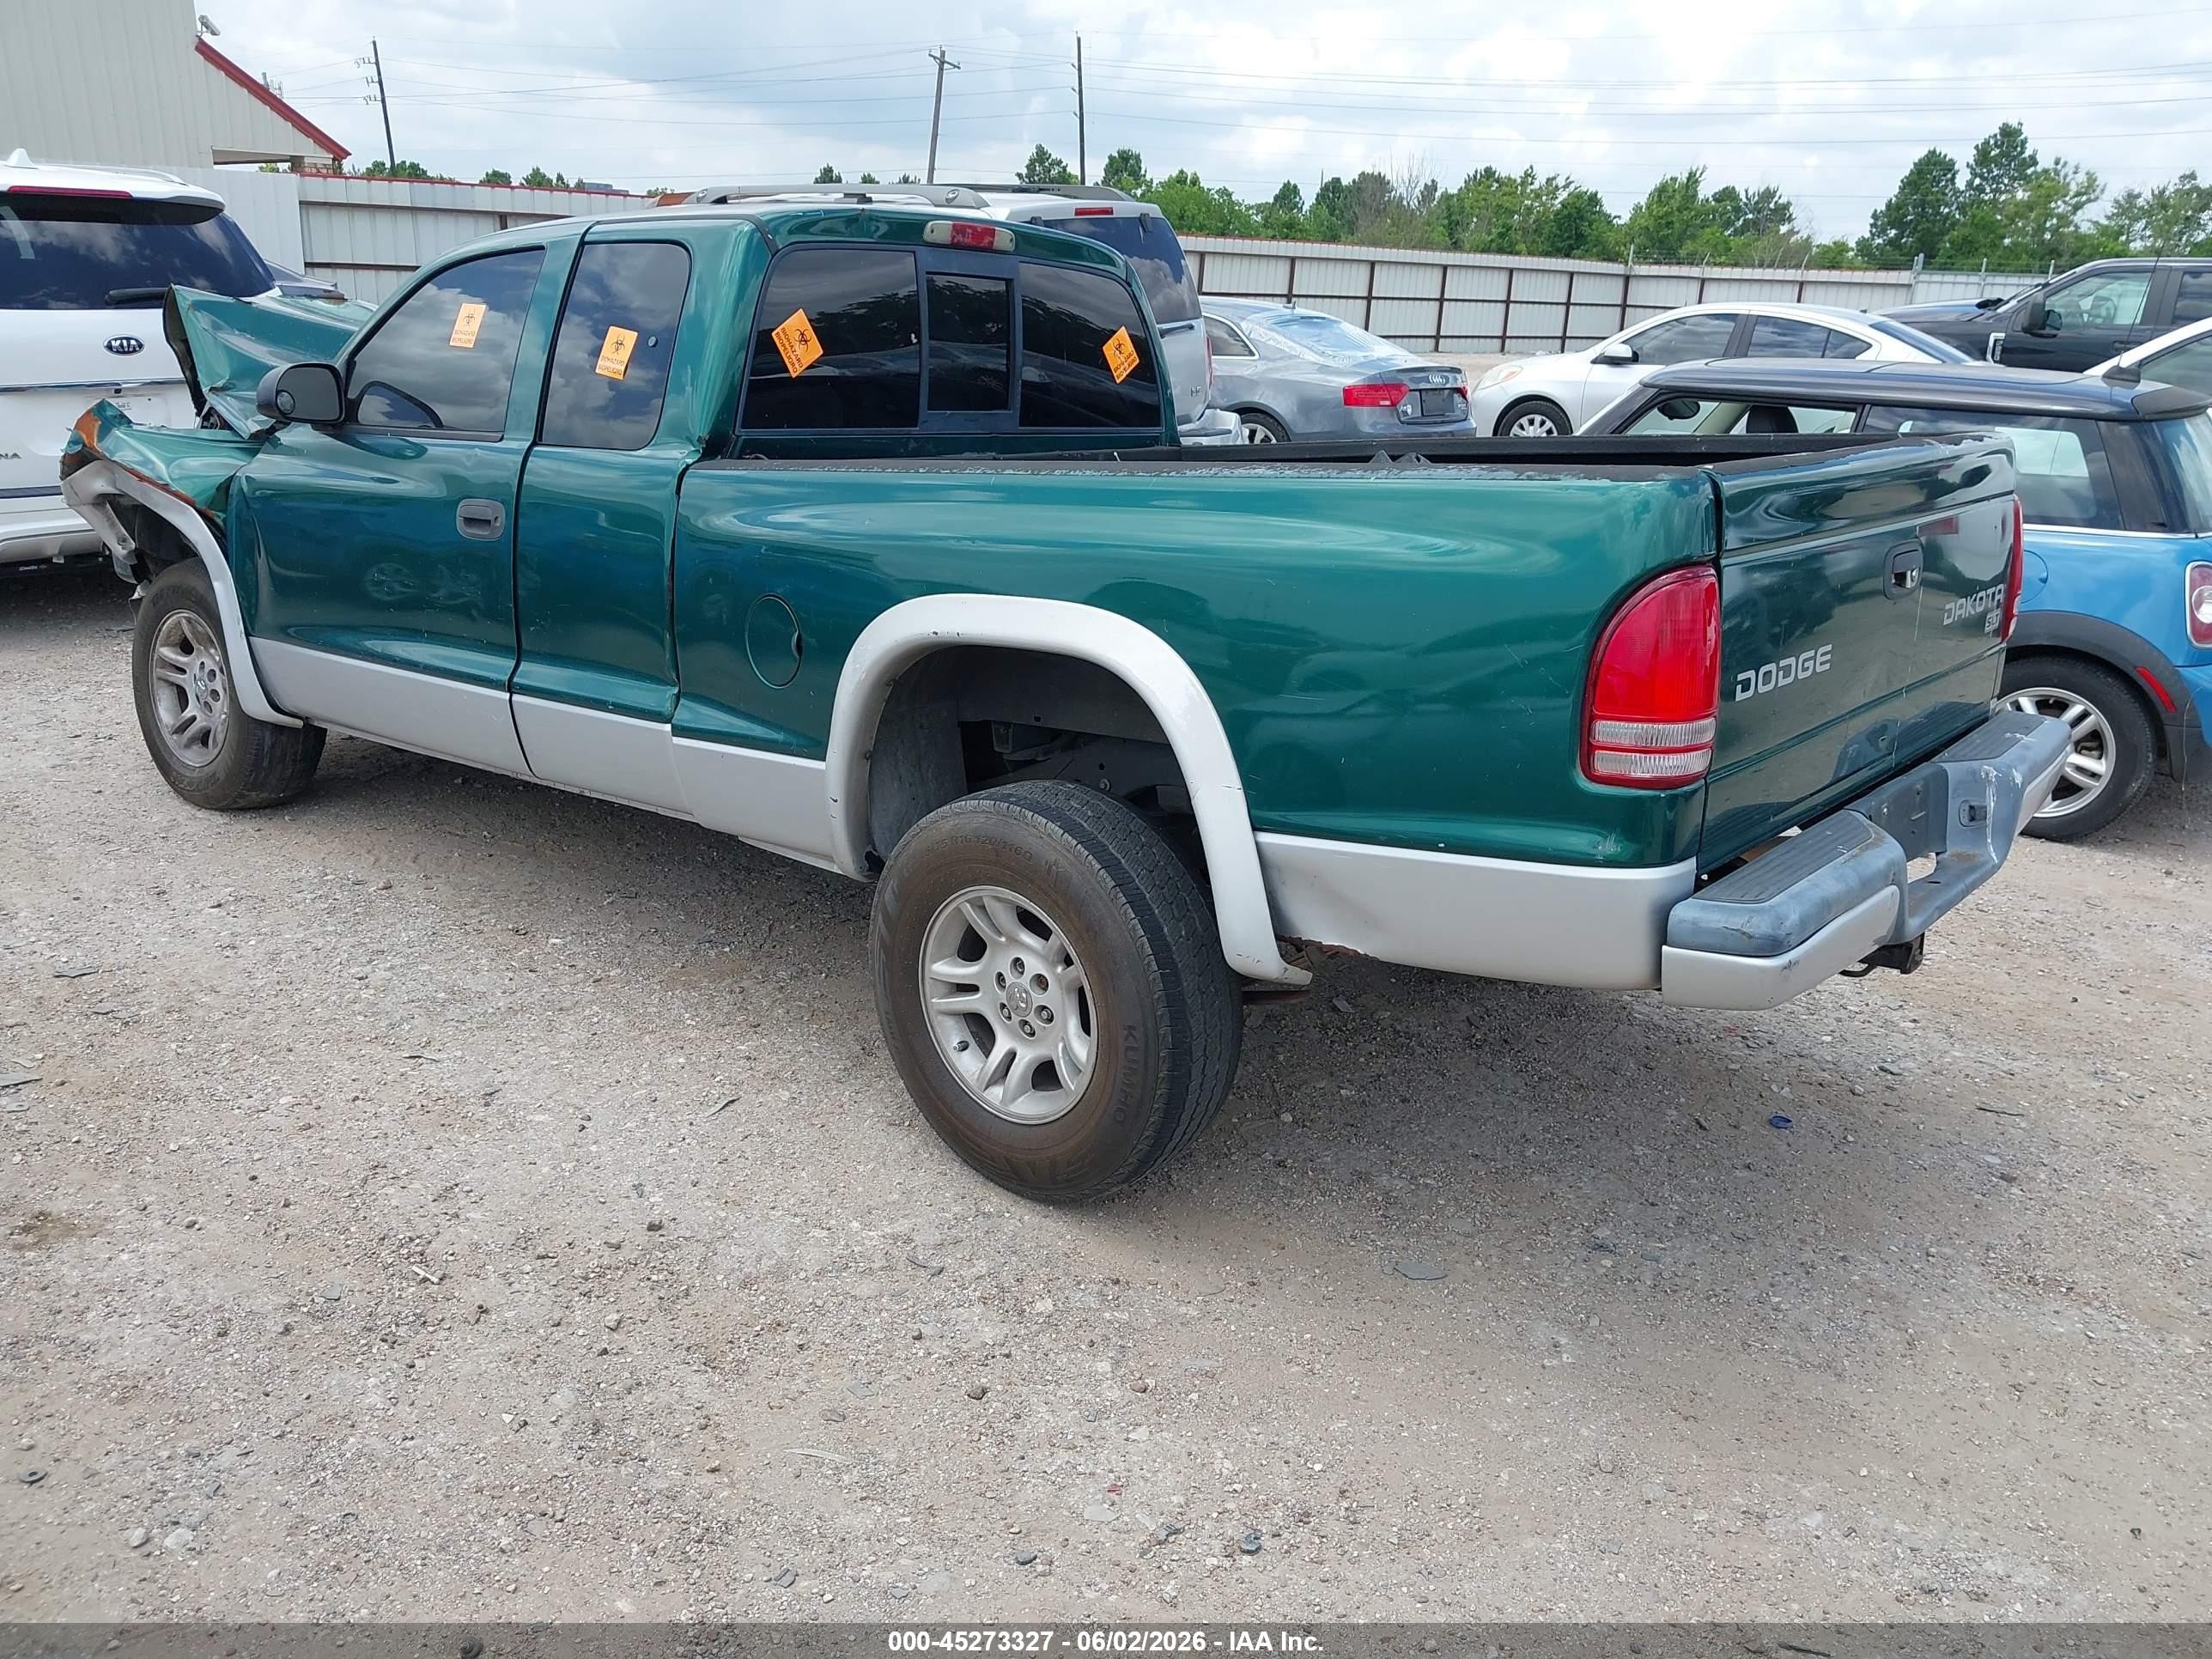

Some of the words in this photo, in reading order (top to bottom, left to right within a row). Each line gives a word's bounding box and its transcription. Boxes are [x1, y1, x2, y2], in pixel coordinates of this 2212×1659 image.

[111, 339, 140, 351] KIA
[775, 331, 799, 374] BIOPELIGRO
[781, 327, 804, 368] BIOHAZARD
[1942, 583, 2005, 626] DAKOTA
[1735, 643, 1832, 702] DODGE
